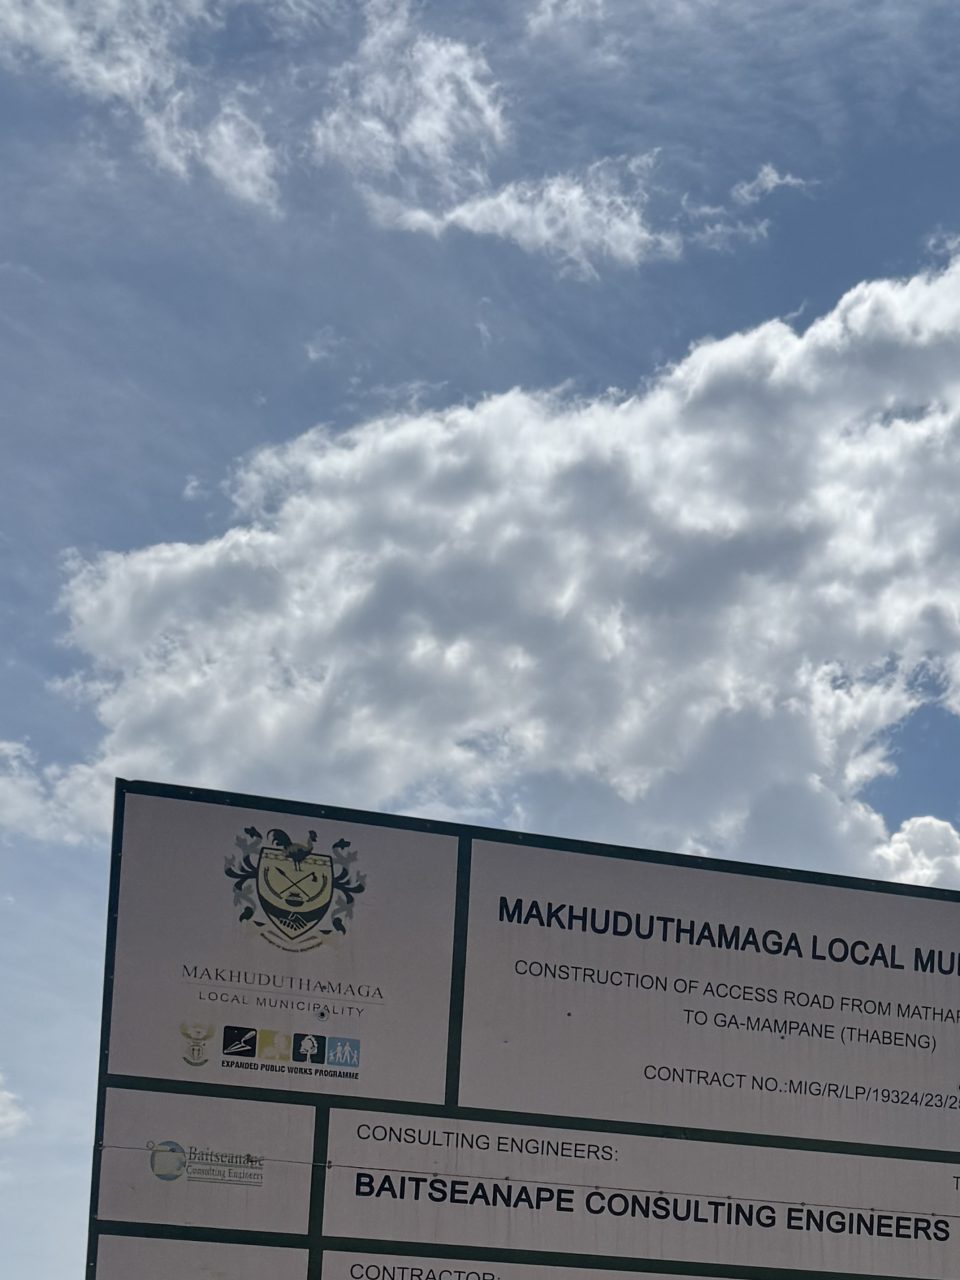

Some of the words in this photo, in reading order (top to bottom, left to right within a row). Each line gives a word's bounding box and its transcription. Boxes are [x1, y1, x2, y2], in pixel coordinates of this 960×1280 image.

[499, 896, 803, 958] MAKHUDUTHAMAGA
[811, 935, 905, 970] LOCAL
[182, 964, 384, 999] MAKHUDUTHAMAGA
[514, 959, 668, 992] CONSTRUCTION
[673, 978, 699, 994] OF
[703, 982, 778, 1004] ACCESS
[783, 991, 835, 1011] ROAD
[840, 997, 892, 1017] FROM
[199, 991, 249, 1006] LOCAL
[255, 997, 365, 1018] MUNICIPALITY
[683, 1009, 708, 1026] TO
[713, 1013, 835, 1041] GA-MAMPANE
[840, 1026, 938, 1053] (THABENG)
[221, 1059, 259, 1071] EXPANDED
[260, 1063, 286, 1074] PUBLIC
[287, 1065, 313, 1076] WORKS
[314, 1068, 360, 1080] PROGRAMME
[643, 1064, 747, 1089] CONTRACT
[356, 1123, 491, 1151] CONSULTING
[497, 1136, 619, 1162] ENGINEERS:
[354, 1172, 575, 1214] BAITSEANAPE
[585, 1191, 777, 1229] CONSULTING
[786, 1207, 951, 1242] ENGINEERS
